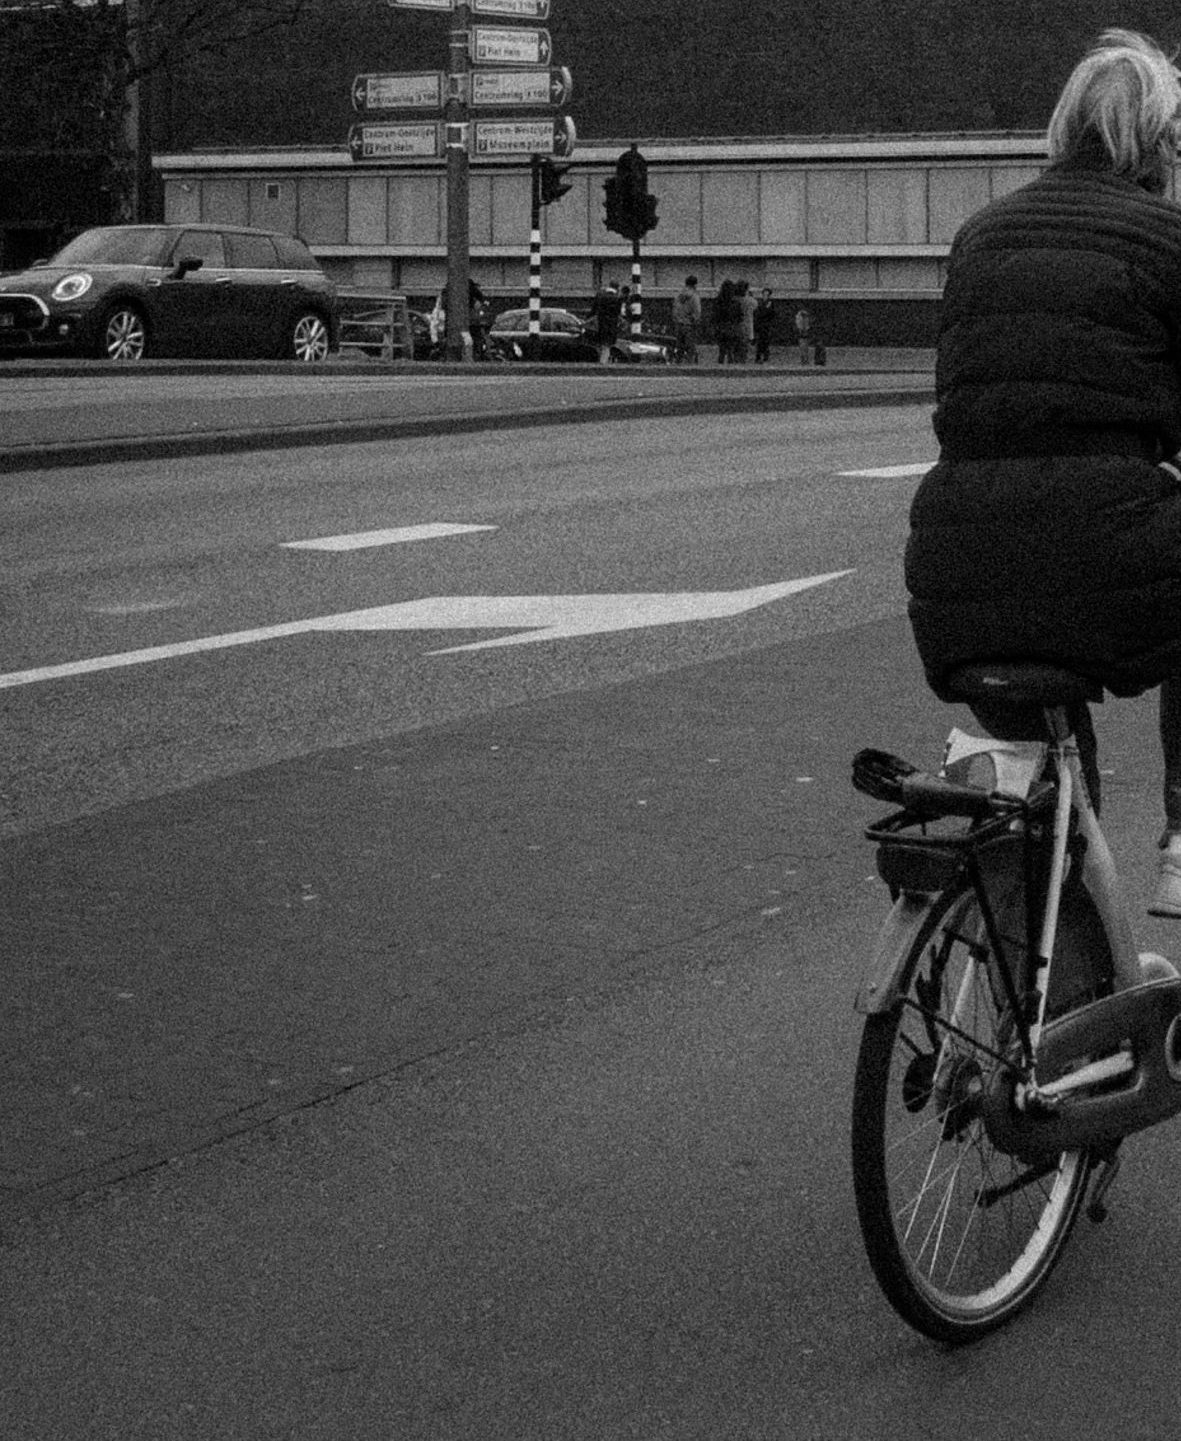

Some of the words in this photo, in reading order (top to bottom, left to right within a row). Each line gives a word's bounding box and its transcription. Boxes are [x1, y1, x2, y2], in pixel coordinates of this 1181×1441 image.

[375, 142, 393, 153] Piet
[394, 142, 415, 153] Hein
[489, 137, 551, 151] Museumplein
